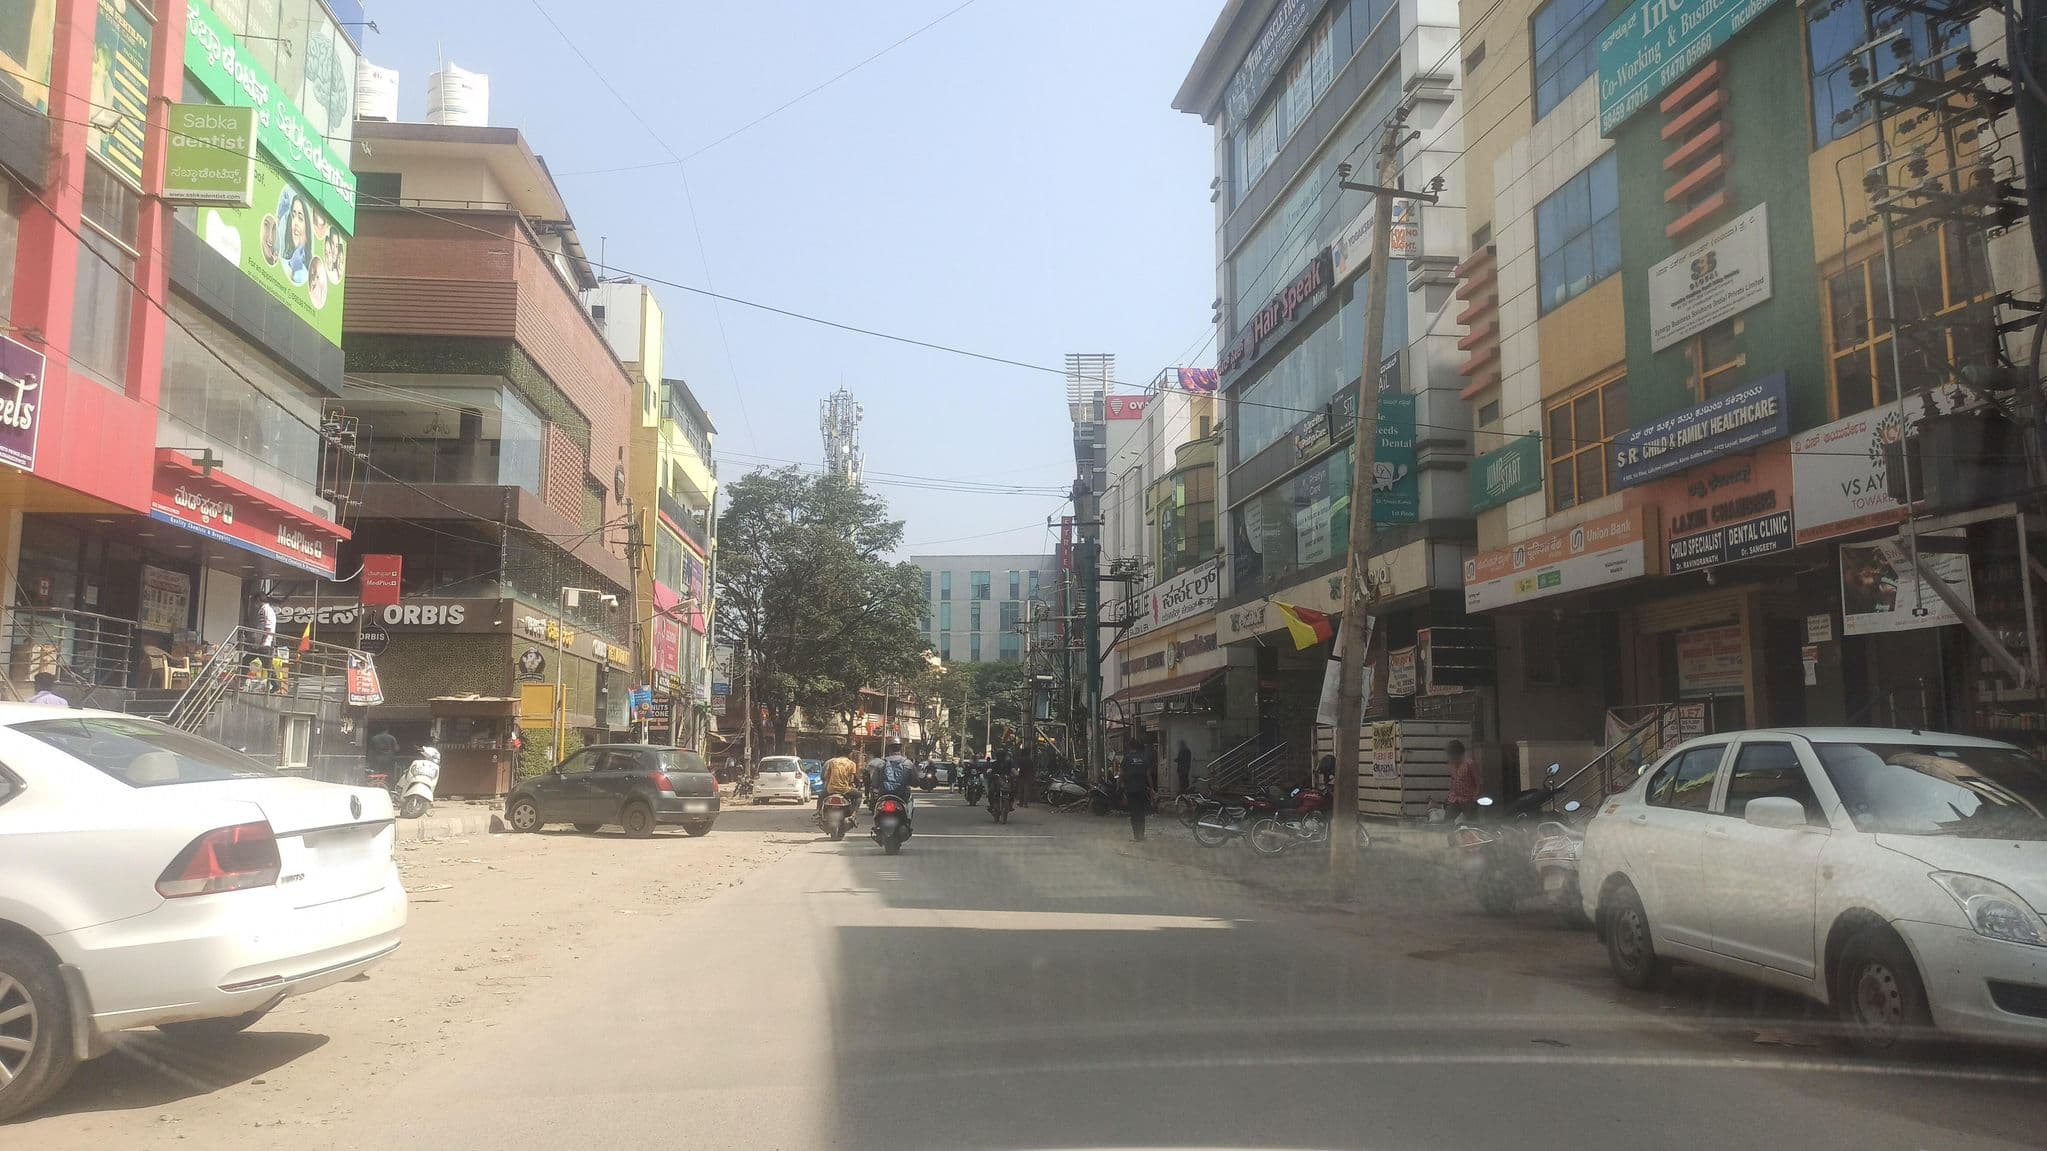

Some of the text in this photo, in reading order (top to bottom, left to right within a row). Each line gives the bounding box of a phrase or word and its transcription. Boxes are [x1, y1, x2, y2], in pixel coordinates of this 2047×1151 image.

[1601, 41, 1662, 100] Co-Working
[1667, 25, 1677, 47] &
[183, 113, 237, 129] Sabka
[172, 134, 244, 150] dentist
[1253, 258, 1321, 343] Hair Speak
[1376, 427, 1399, 435] eeds
[1382, 439, 1412, 449] Dental
[1618, 451, 1625, 468] S
[1629, 447, 1638, 464] R
[1642, 437, 1668, 459] CHILD
[1677, 420, 1709, 448] FAMILY
[1710, 396, 1777, 435] HEALTHCARE
[1486, 457, 1503, 490] JUMP
[1501, 457, 1521, 494] START
[1841, 479, 1861, 497] VS
[277, 524, 314, 555] MedPlus
[1586, 519, 1632, 542] Union Bank
[1728, 523, 1758, 546] DENTAL
[1760, 515, 1788, 538] CLINIC
[1670, 531, 1722, 560] CHILD SPECIALIST
[383, 604, 465, 625] ORBIS
[360, 632, 385, 641] ORBIS
